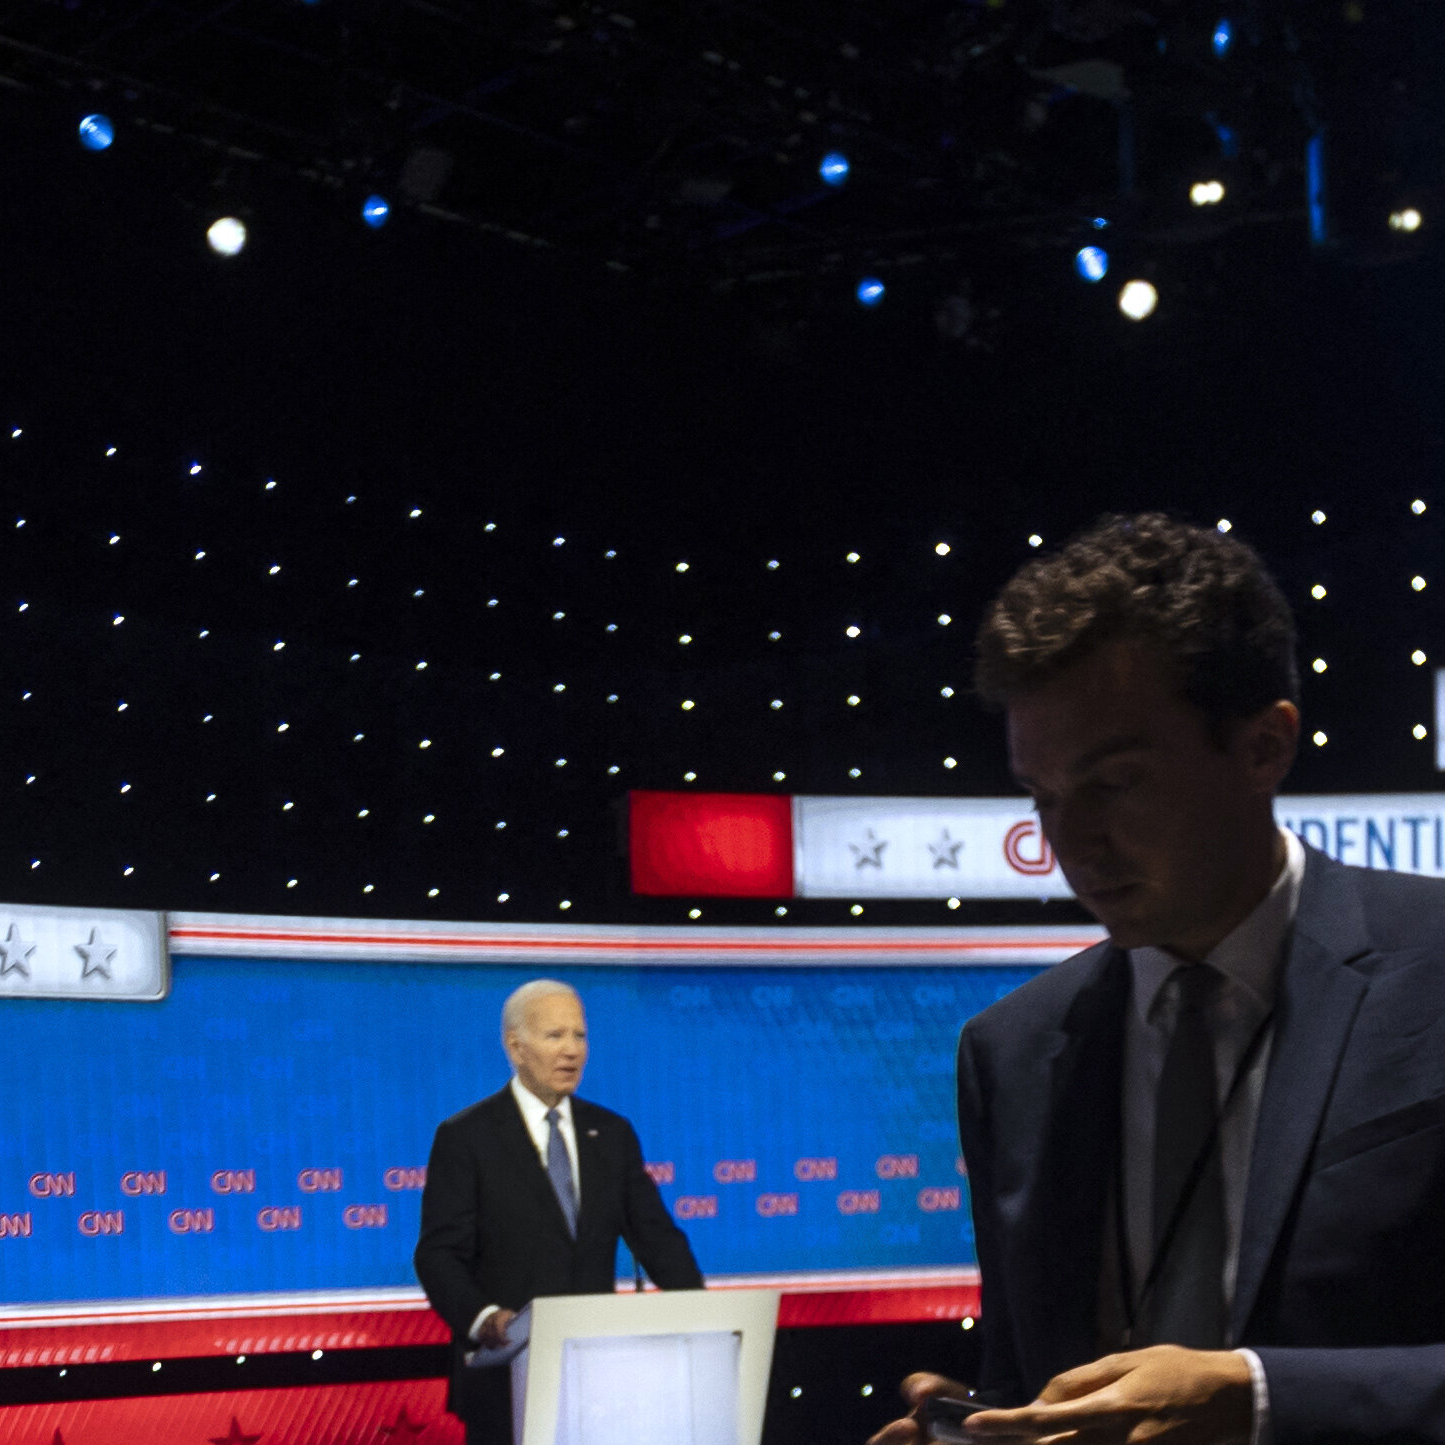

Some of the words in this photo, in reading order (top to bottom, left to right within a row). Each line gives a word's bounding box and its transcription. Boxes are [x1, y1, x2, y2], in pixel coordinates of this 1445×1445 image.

[28, 1171, 75, 1198] CNN
[120, 1170, 166, 1196] CNN
[210, 1169, 256, 1194] CNN
[297, 1168, 343, 1193] CNN
[77, 1210, 124, 1236] CNN
[168, 1208, 215, 1234] CNN
[257, 1206, 302, 1231] CNN
[343, 1204, 388, 1229] CNN
